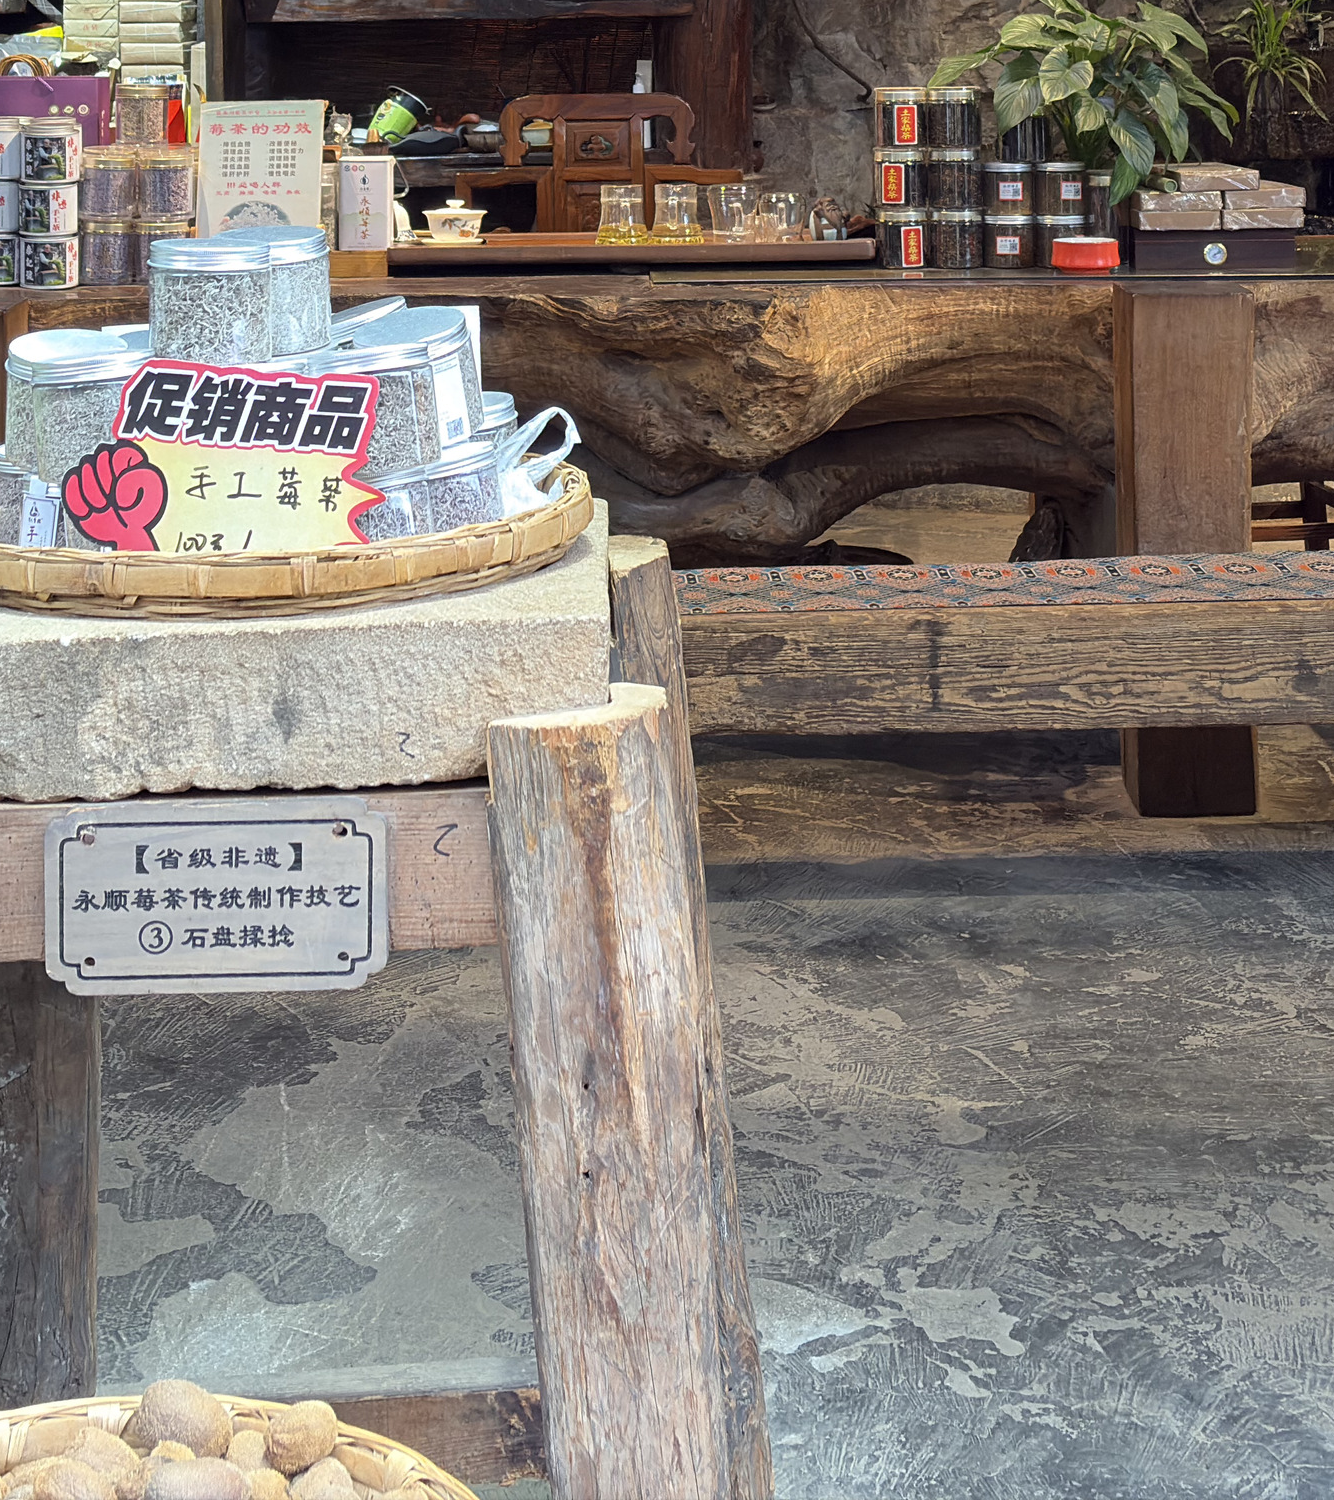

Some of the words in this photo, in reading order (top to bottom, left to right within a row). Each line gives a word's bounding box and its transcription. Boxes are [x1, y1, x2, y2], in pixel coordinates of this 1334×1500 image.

[121, 369, 369, 451] 促销商品
[185, 466, 344, 512] 手工莓茶
[71, 884, 362, 913] 永顺莓茶传统制作技艺
